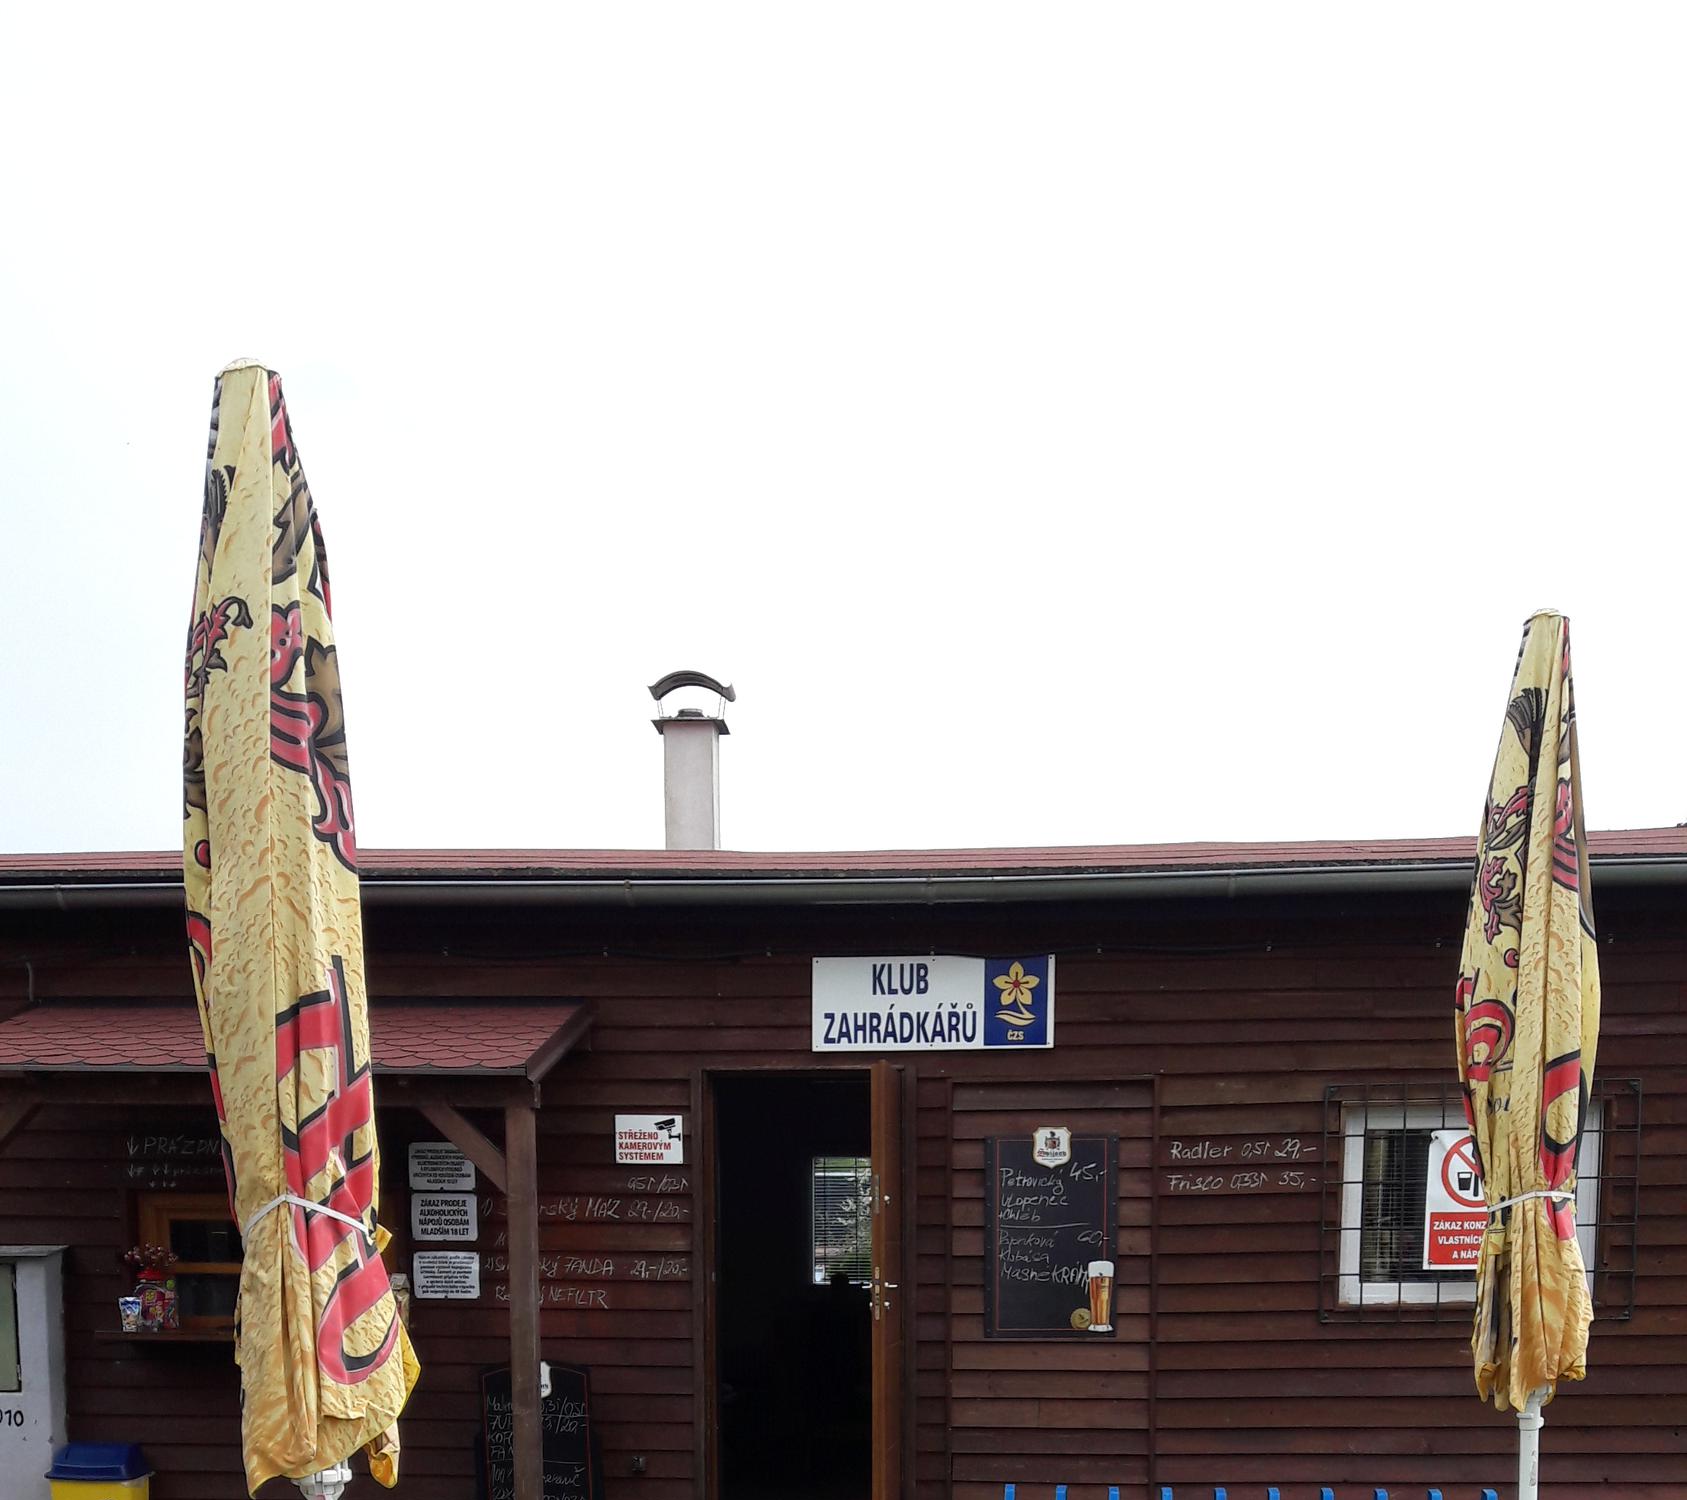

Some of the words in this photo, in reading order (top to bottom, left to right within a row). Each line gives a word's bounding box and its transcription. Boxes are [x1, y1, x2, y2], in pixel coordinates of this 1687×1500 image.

[872, 963, 929, 995] KLUB
[823, 1002, 977, 1044] ZAHRÁDKÁŘŮ
[1007, 1030, 1024, 1041] ČZS
[618, 1129, 659, 1140] STŘEŽENO
[618, 1140, 672, 1150] KAMEROVÝM
[1171, 1141, 1233, 1159] Radler
[618, 1150, 664, 1161] SYSTÉMEM
[1166, 1173, 1224, 1191] Frisco
[420, 1198, 440, 1207] ZÁKAZ
[441, 1199, 467, 1207] PRODEJE
[420, 1208, 468, 1216] ALKOHOLICKÝCH
[419, 1217, 442, 1226] NÁPOJŮ
[443, 1217, 469, 1226] OSOBÁM
[1433, 1219, 1462, 1230] ZÁKAZ
[1463, 1221, 1487, 1230] KONZ
[421, 1227, 449, 1235] MLADŠÍM
[1438, 1234, 1484, 1245] VLASTNÍCH
[1452, 1251, 1459, 1259] A
